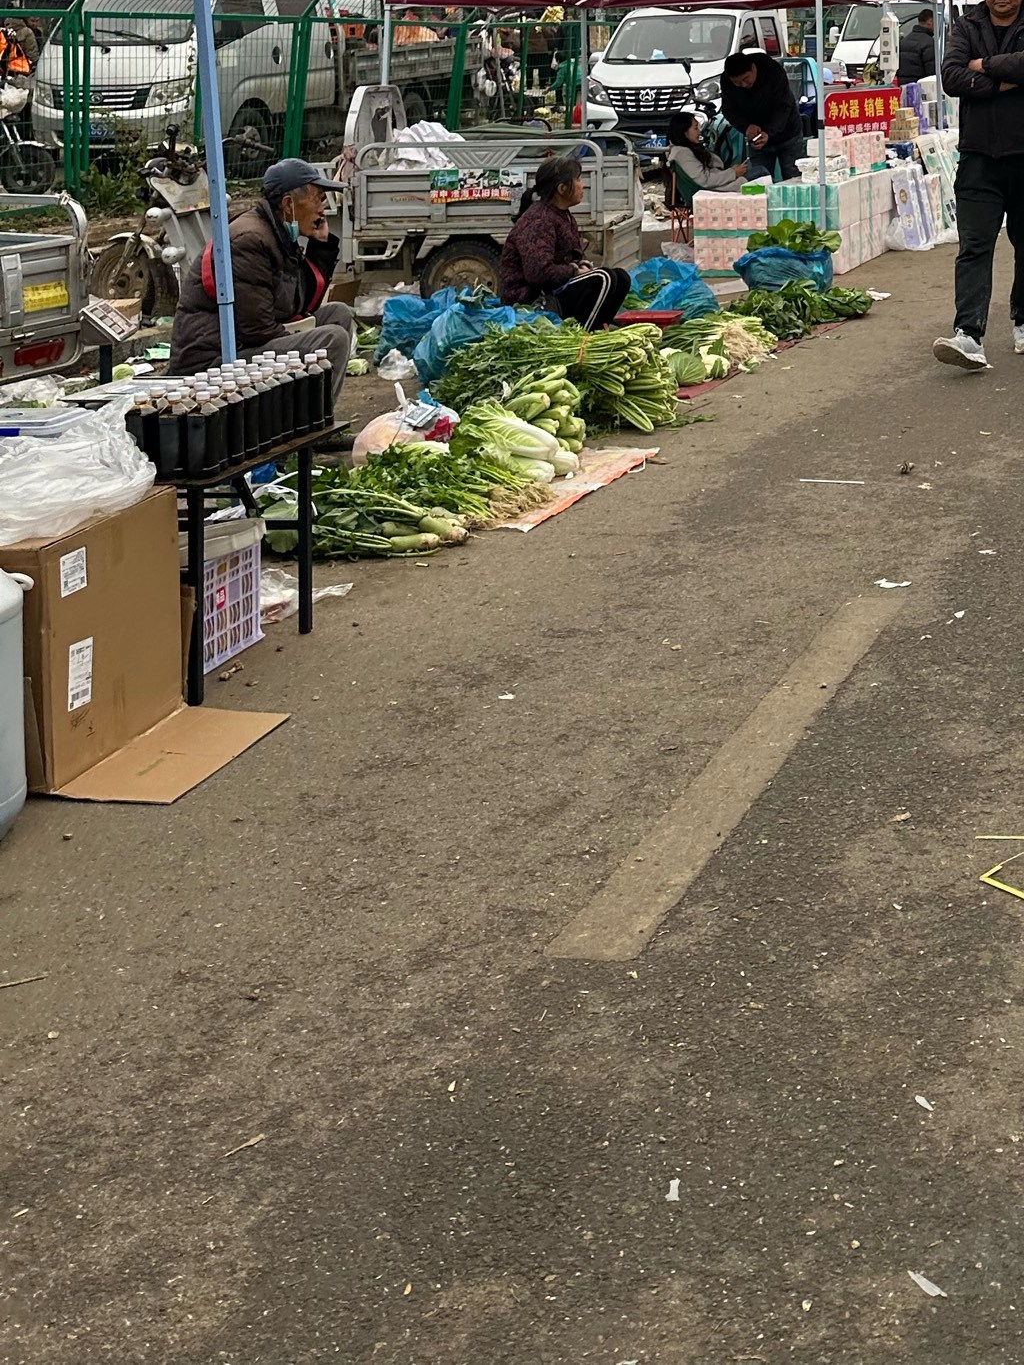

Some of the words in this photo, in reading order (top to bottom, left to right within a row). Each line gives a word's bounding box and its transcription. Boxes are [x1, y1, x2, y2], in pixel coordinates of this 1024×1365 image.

[828, 99, 860, 120] 净水器
[864, 97, 884, 117] 销售
[839, 121, 888, 134] 州荣盛华府店
